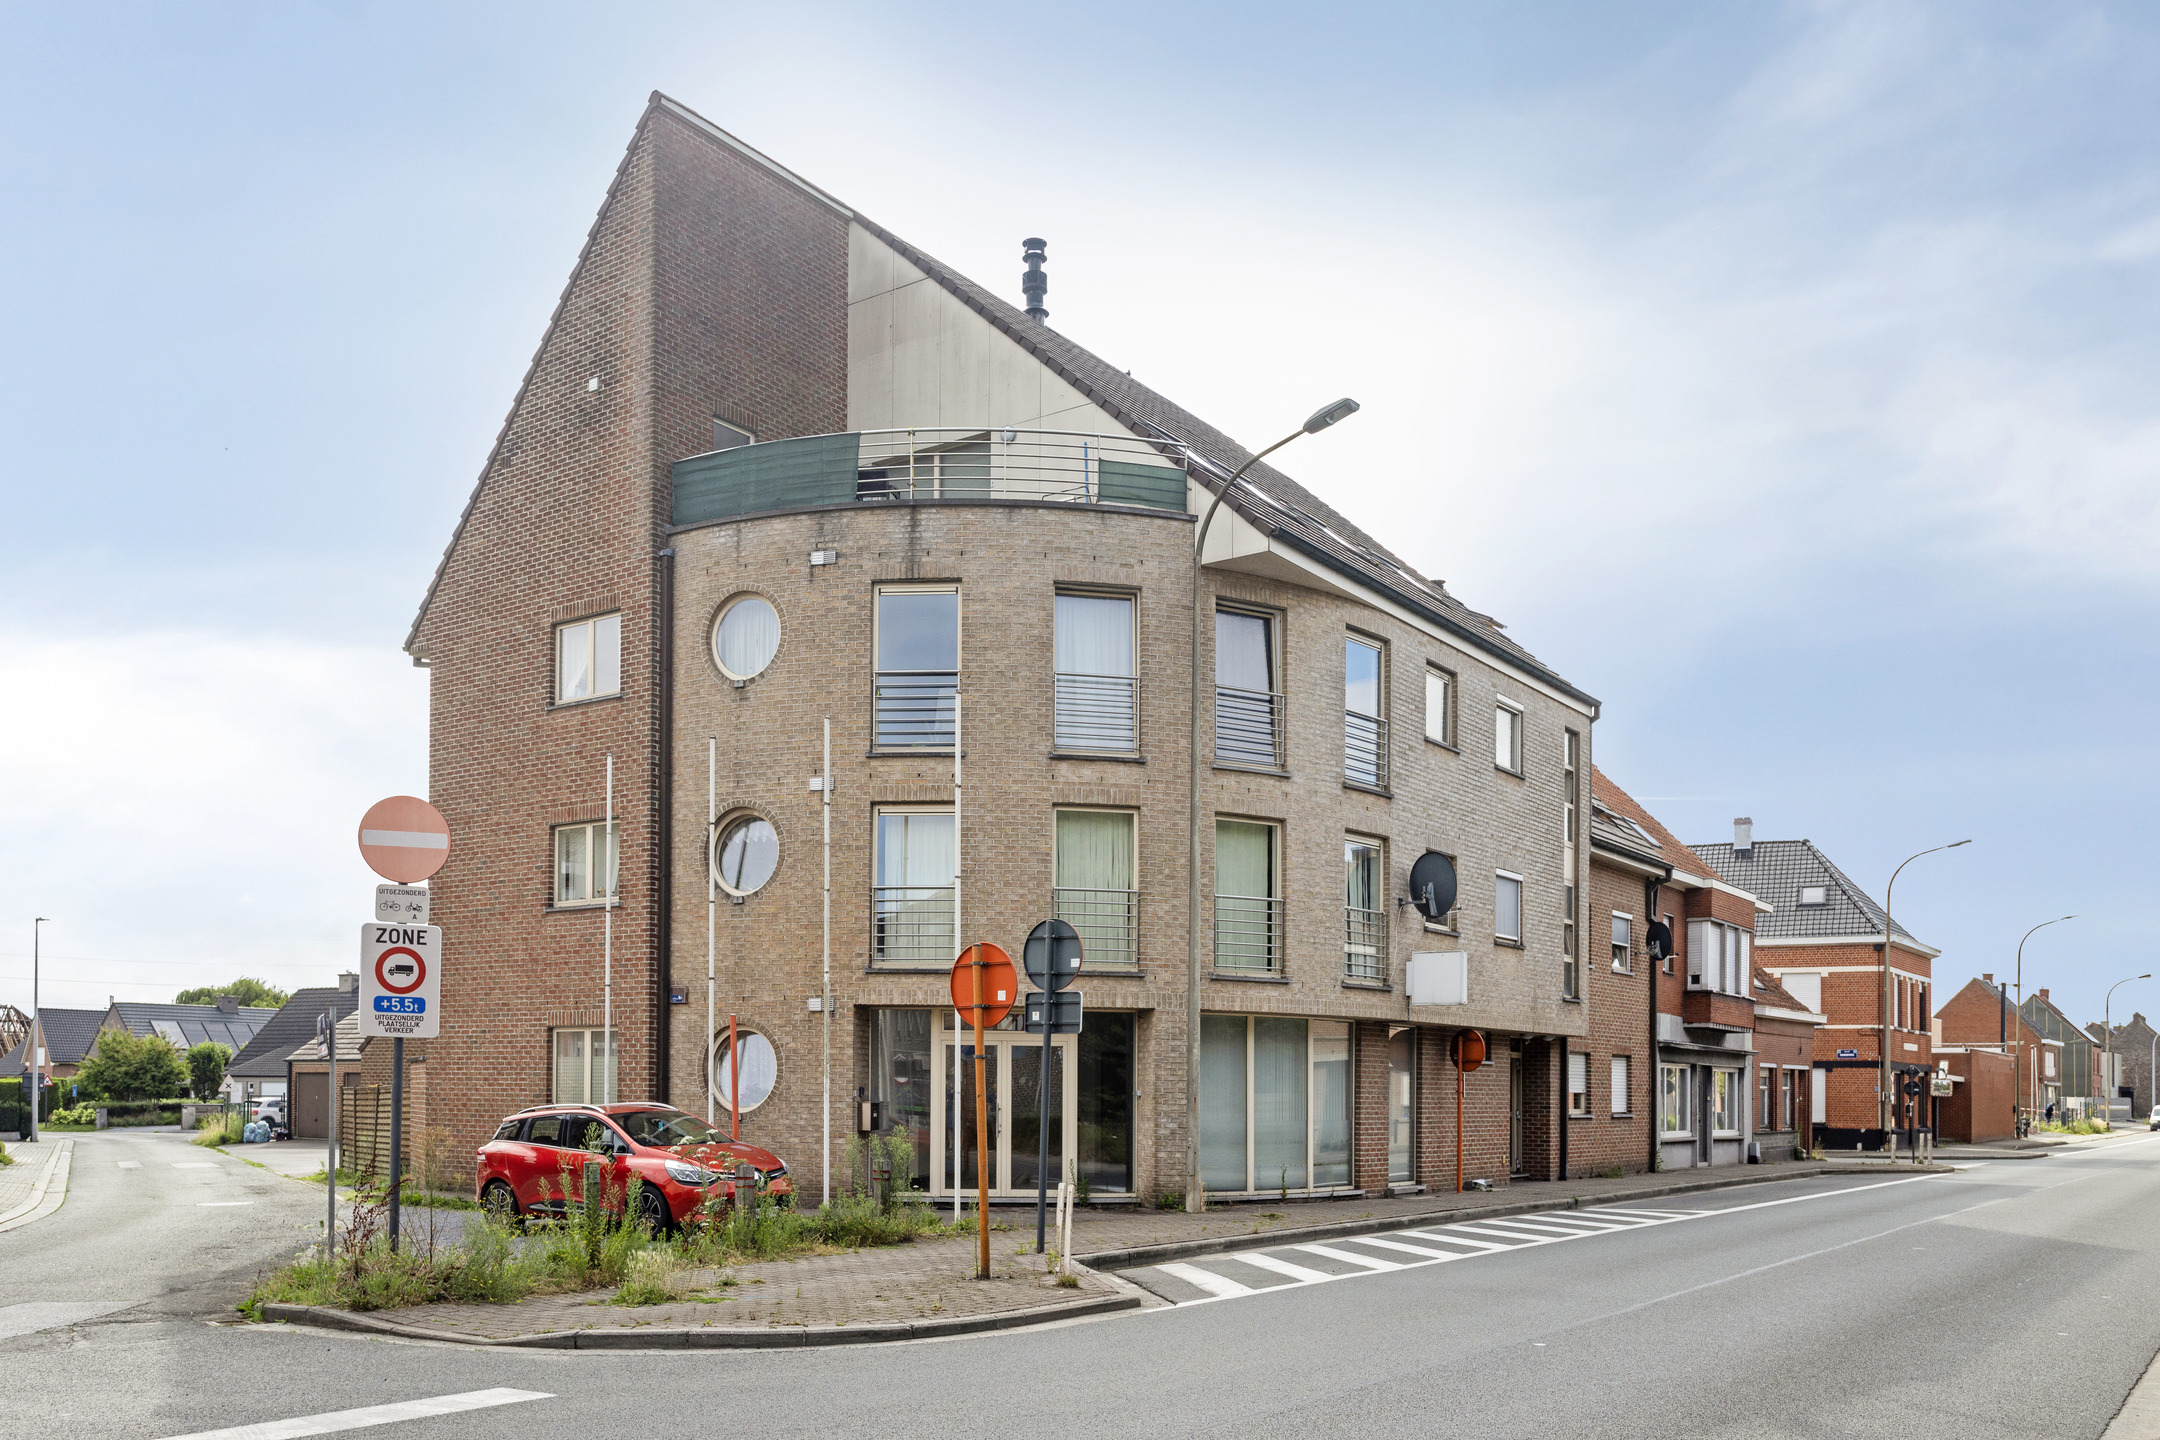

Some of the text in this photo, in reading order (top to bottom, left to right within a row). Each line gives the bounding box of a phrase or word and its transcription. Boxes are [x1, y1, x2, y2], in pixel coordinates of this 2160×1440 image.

[379, 888, 426, 896] UITGEZONDERD
[375, 927, 427, 946] ZONE
[378, 1020, 420, 1028] PLAATSELIJK
[384, 1026, 414, 1034] VERKEER
